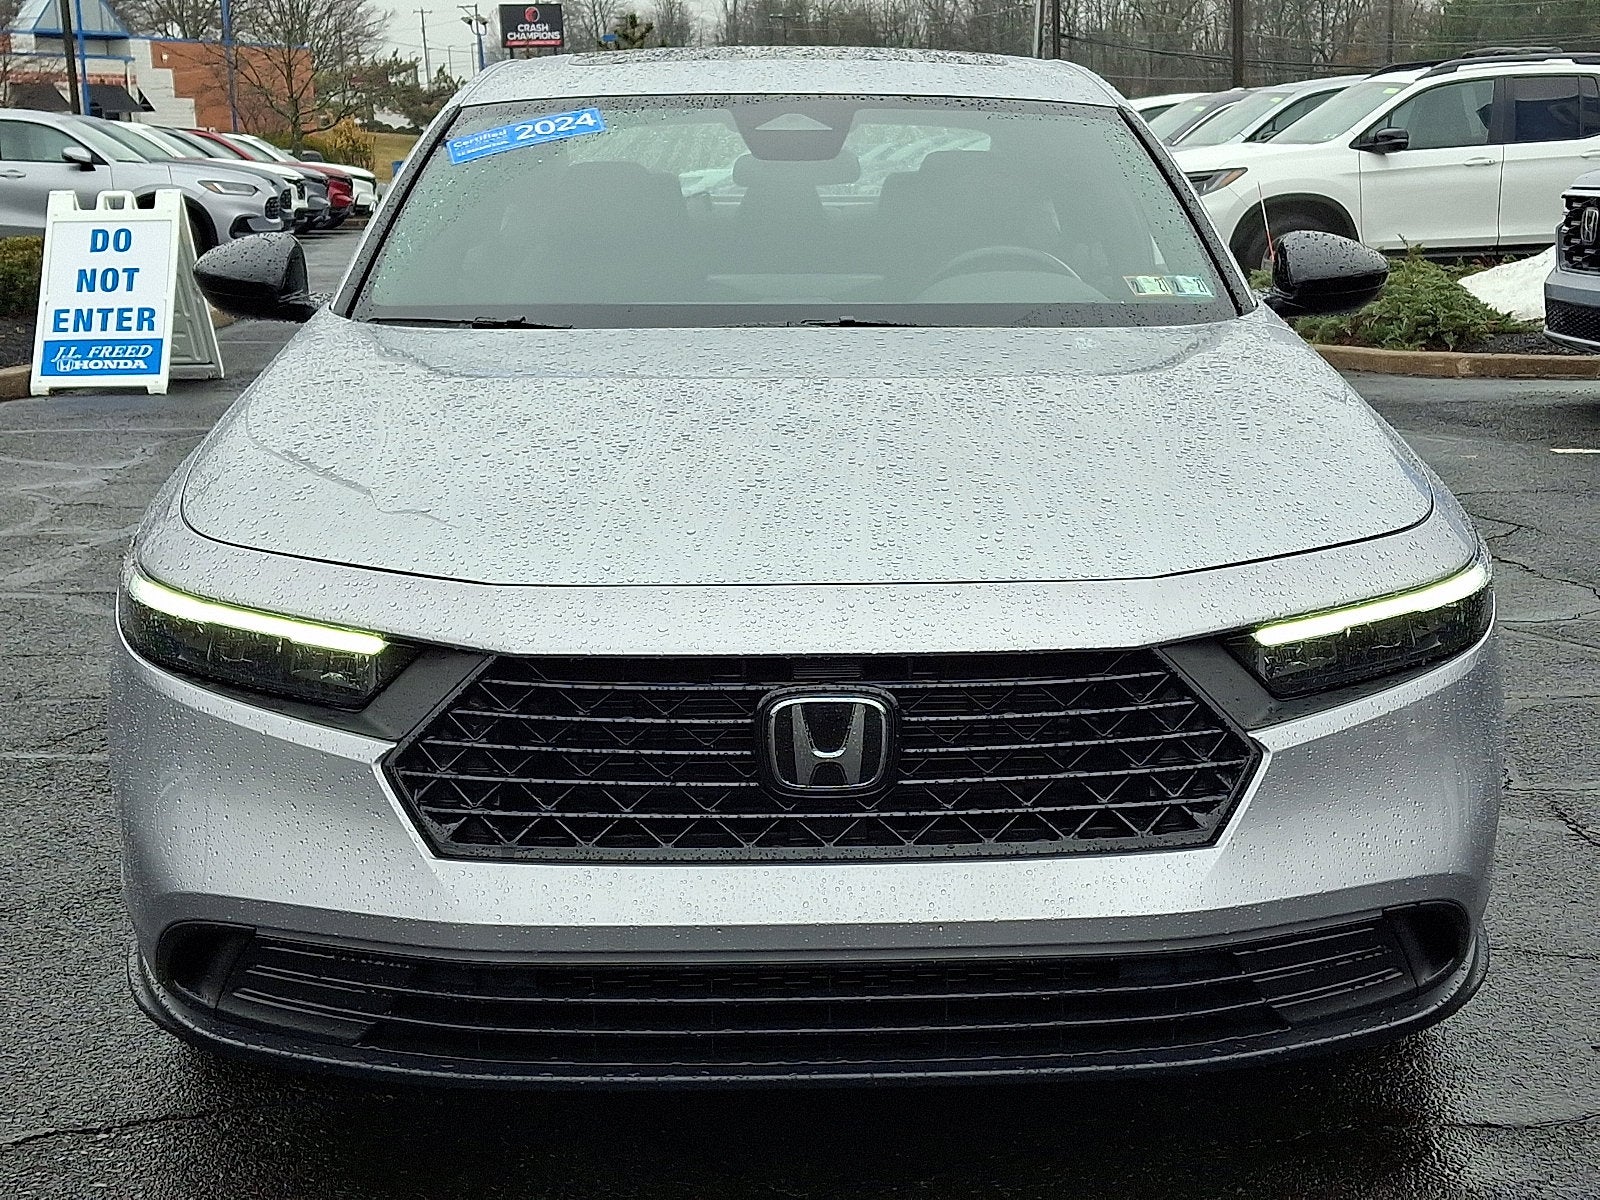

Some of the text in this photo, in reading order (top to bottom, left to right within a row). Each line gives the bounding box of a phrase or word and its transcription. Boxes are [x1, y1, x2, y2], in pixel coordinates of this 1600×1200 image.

[507, 31, 560, 40] CHAMPIONS
[517, 23, 549, 32] CRASH
[515, 113, 597, 141] 2024
[89, 228, 132, 253] DO
[76, 267, 140, 293] NOT
[52, 307, 156, 333] ENTER
[87, 344, 153, 358] FREED
[74, 359, 147, 370] HONDA
